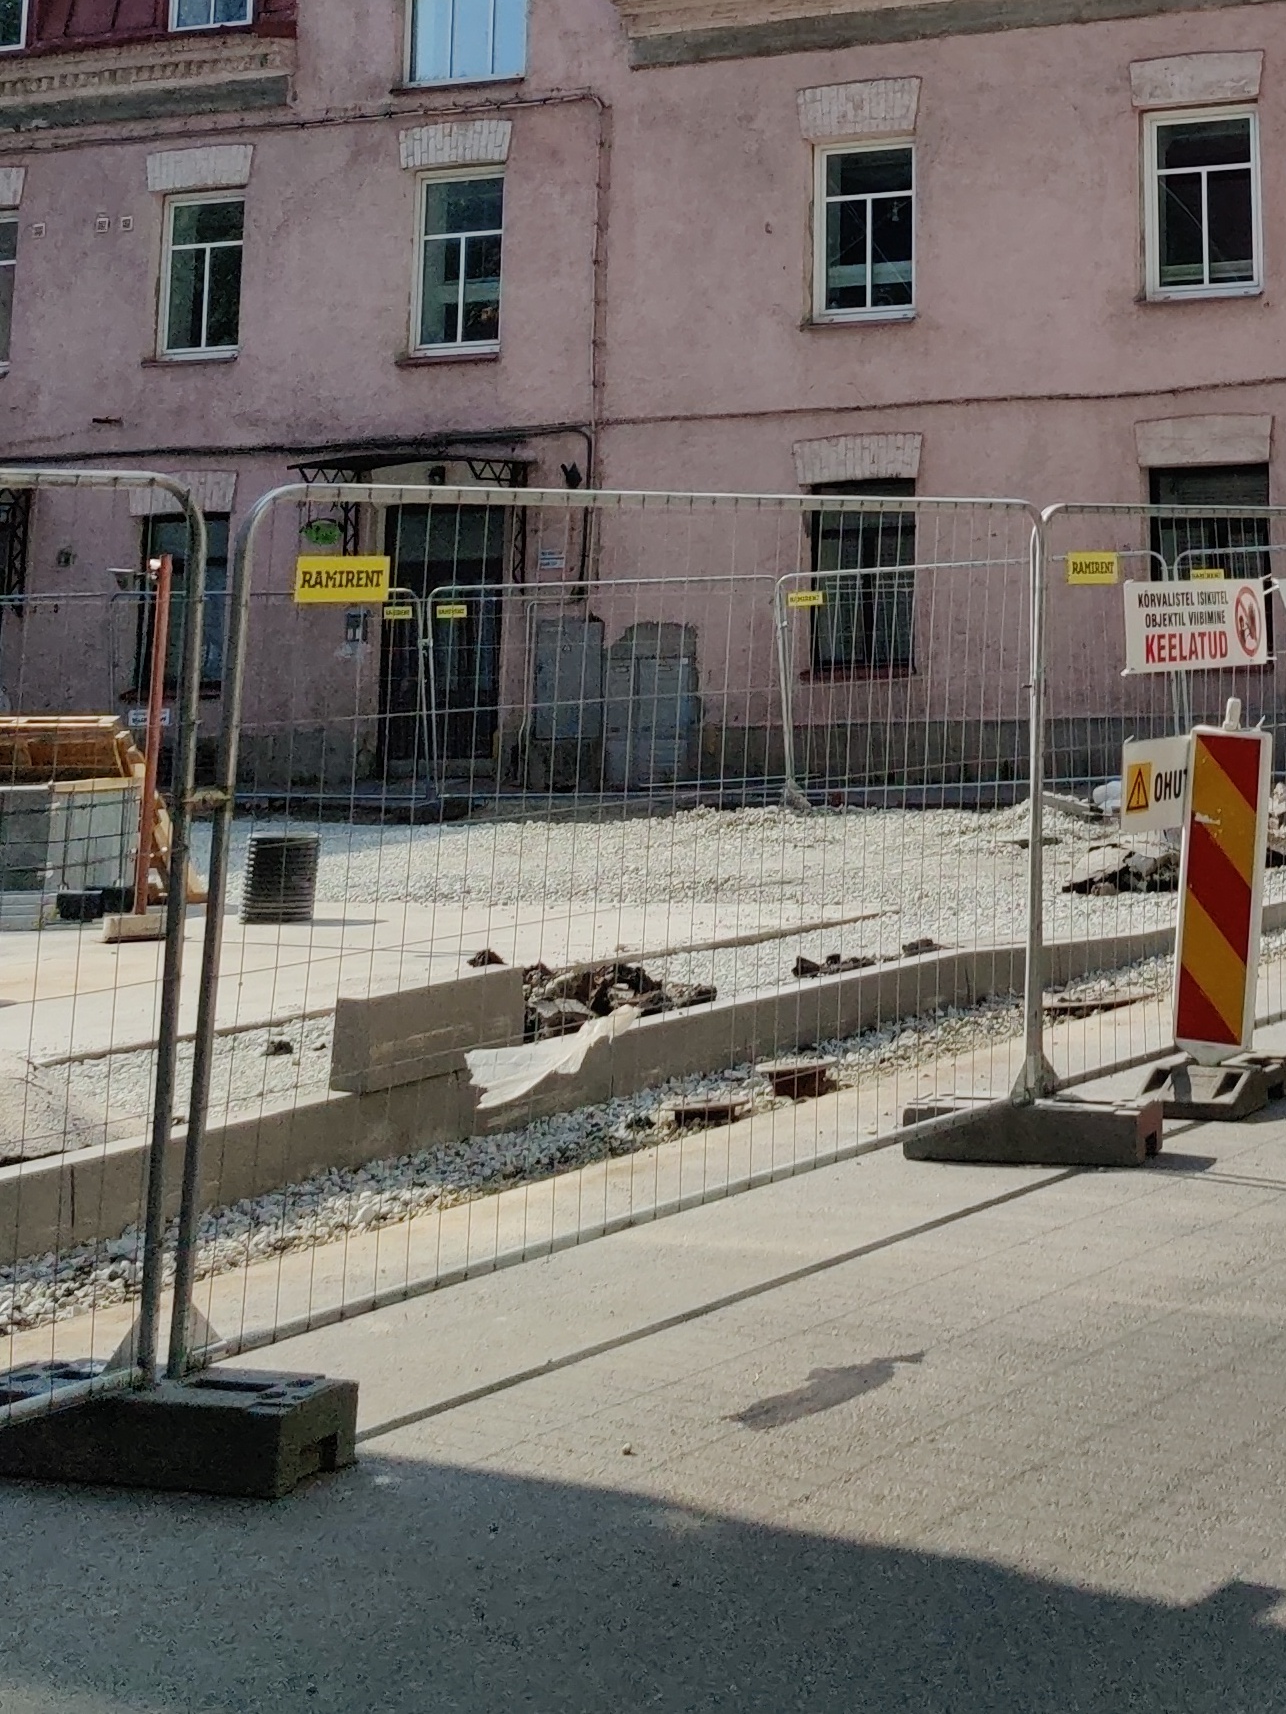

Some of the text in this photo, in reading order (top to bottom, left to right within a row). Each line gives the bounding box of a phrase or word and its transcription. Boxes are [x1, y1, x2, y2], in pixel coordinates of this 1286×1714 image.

[1071, 560, 1115, 575] RAMIRENT
[300, 569, 384, 589] RAMIRENT
[1196, 590, 1229, 606] ISIKUTEL
[1145, 609, 1226, 629] OBJEKTIL VIIBIMINE
[1145, 630, 1229, 665] KEELATUD
